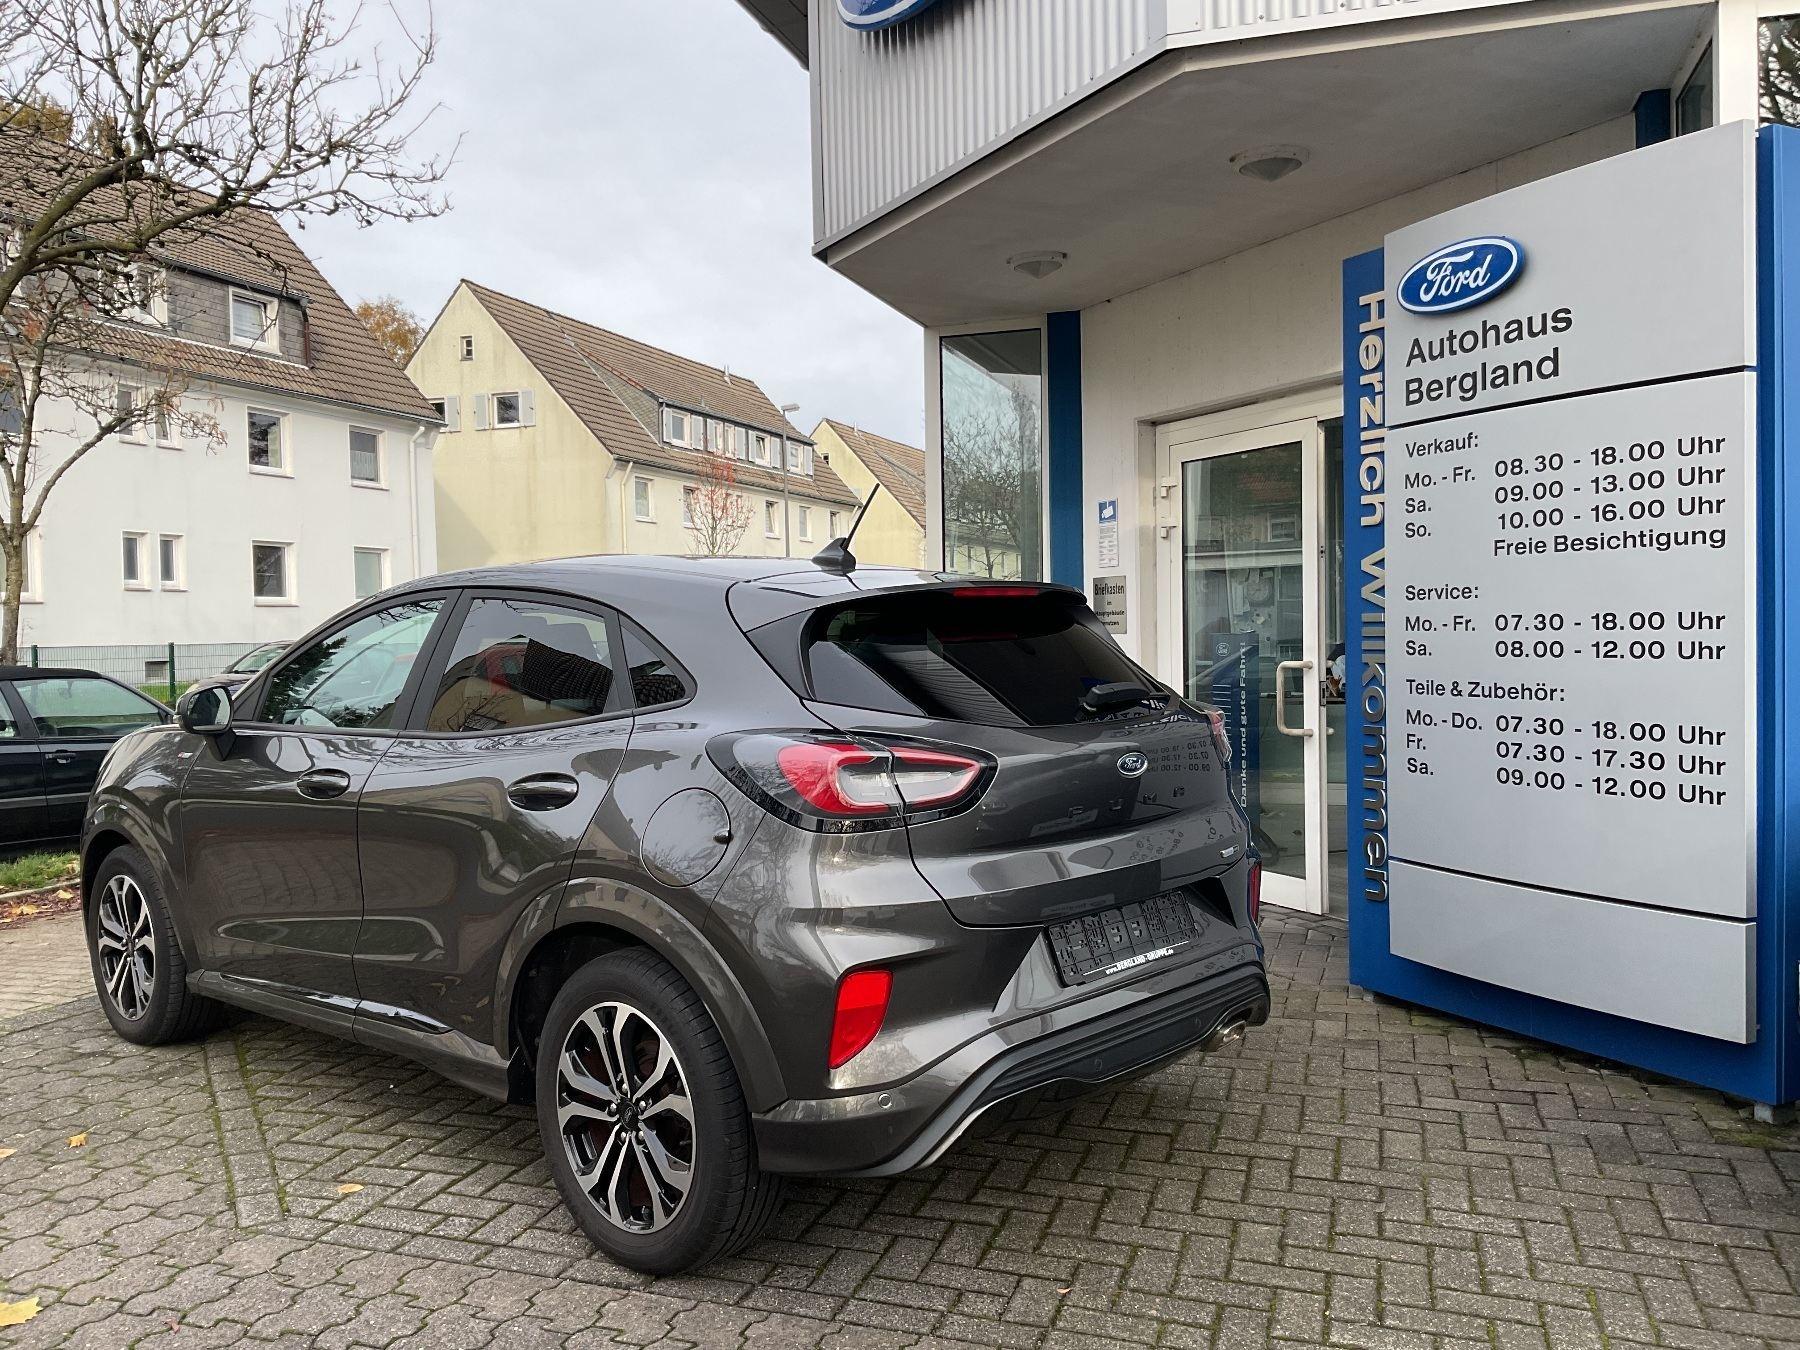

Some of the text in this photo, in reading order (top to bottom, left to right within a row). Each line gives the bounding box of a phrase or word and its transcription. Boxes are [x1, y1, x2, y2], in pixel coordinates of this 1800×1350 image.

[1420, 251, 1492, 302] Ford
[1406, 307, 1572, 367] Autohaus
[1406, 347, 1560, 406] Bergland
[1405, 473, 1437, 490] Mo.
[1454, 466, 1475, 483] Fr.
[1494, 453, 1563, 478] 08.30
[1590, 441, 1665, 466] 18.00
[1677, 436, 1726, 457] Uhr
[1406, 432, 1478, 458] Verkauf:
[1405, 498, 1432, 514] Sa.
[1494, 481, 1564, 504] 09.00
[1590, 470, 1665, 495] 13.00
[1677, 466, 1726, 487] Uhr
[1405, 523, 1432, 539] So.
[1497, 508, 1564, 530] 10.00
[1590, 500, 1665, 523] 16.00
[1677, 496, 1726, 517] Uhr
[1494, 528, 1726, 557] Freie Besichtigung
[1095, 583, 1125, 596] Briefkasten
[1359, 290, 1388, 902] Herzlich Willkommen
[1405, 583, 1479, 602] Service:
[1405, 616, 1437, 632] Mo.
[1454, 616, 1476, 632] Fr.
[1494, 613, 1564, 632] 07.30
[1590, 612, 1665, 631] 18.00
[1677, 611, 1726, 631] Uhr
[1405, 640, 1432, 657] Sa.
[1495, 640, 1564, 659] 08.00
[1591, 640, 1665, 660] 12.00
[1677, 640, 1726, 660] Uhr
[1239, 691, 1248, 726] gute
[1405, 678, 1565, 702] Teile & Zubehör:
[1239, 727, 1248, 757] und
[1406, 709, 1438, 728] Mo.
[1451, 713, 1483, 731] Do.
[1495, 715, 1564, 736] 07.30
[1591, 720, 1666, 743] 18.00
[1678, 724, 1726, 747] Uhr
[1406, 733, 1427, 751] Fr.
[1496, 740, 1565, 764] 07.30
[1591, 749, 1666, 772] 17.30
[1678, 754, 1727, 777] Uhr
[1240, 760, 1248, 808] Danke
[1407, 757, 1434, 777] Sa.
[1496, 767, 1565, 791] 09.00
[1591, 777, 1666, 801] 12.00
[1678, 783, 1727, 806] Uhr
